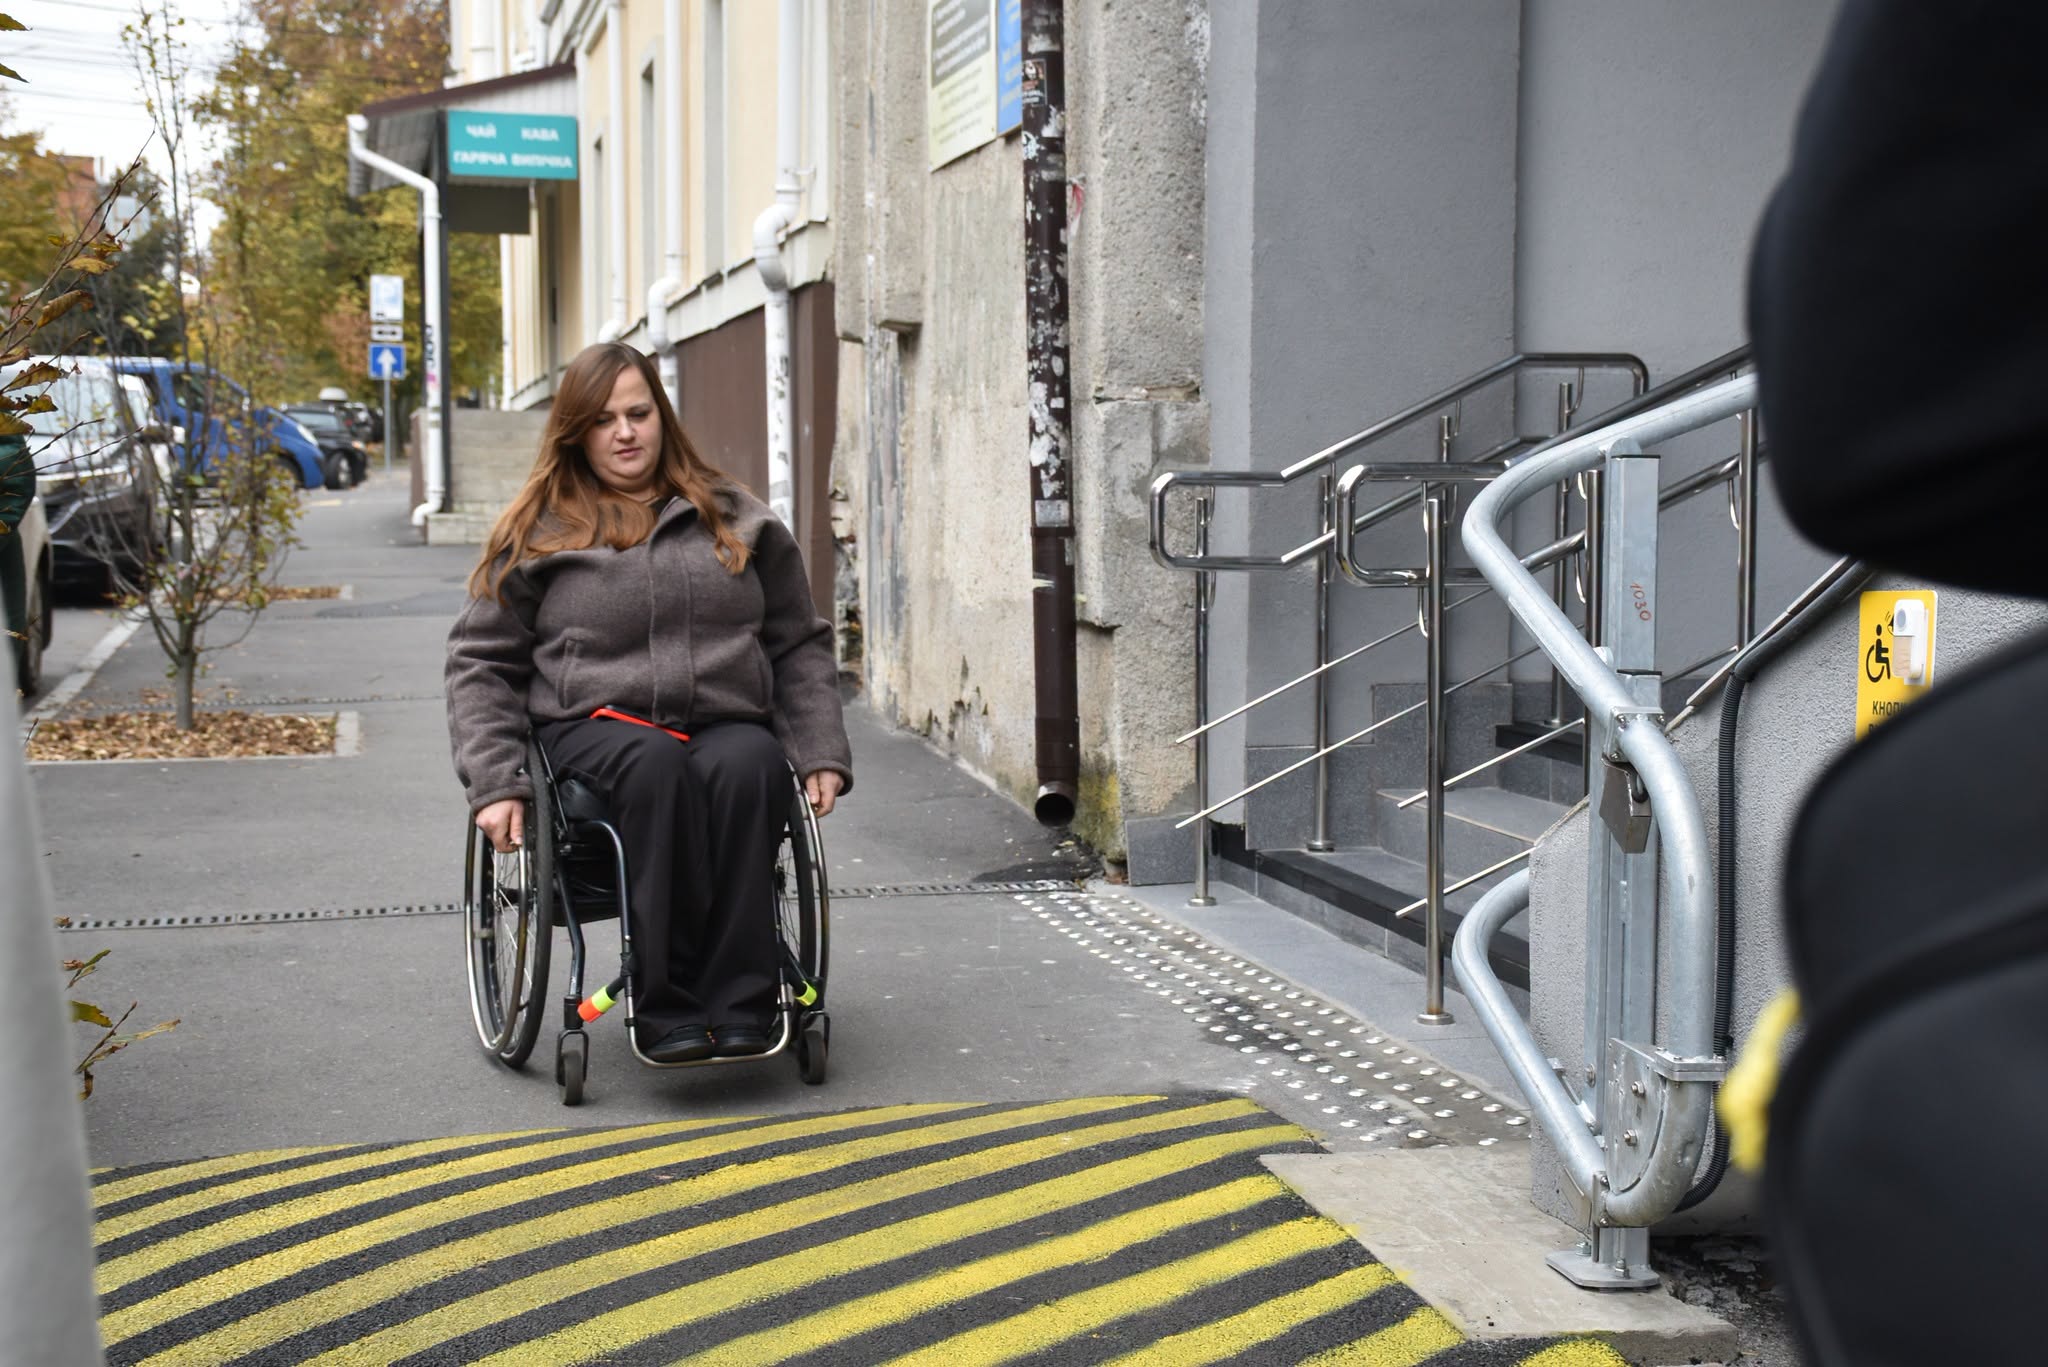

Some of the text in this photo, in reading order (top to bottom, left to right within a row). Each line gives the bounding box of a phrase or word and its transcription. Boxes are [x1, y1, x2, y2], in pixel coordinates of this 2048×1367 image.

[465, 122, 560, 141] ЧАЙ КАВА
[453, 150, 508, 166] ГАРЯЧА
[1630, 583, 1652, 621] 1030
